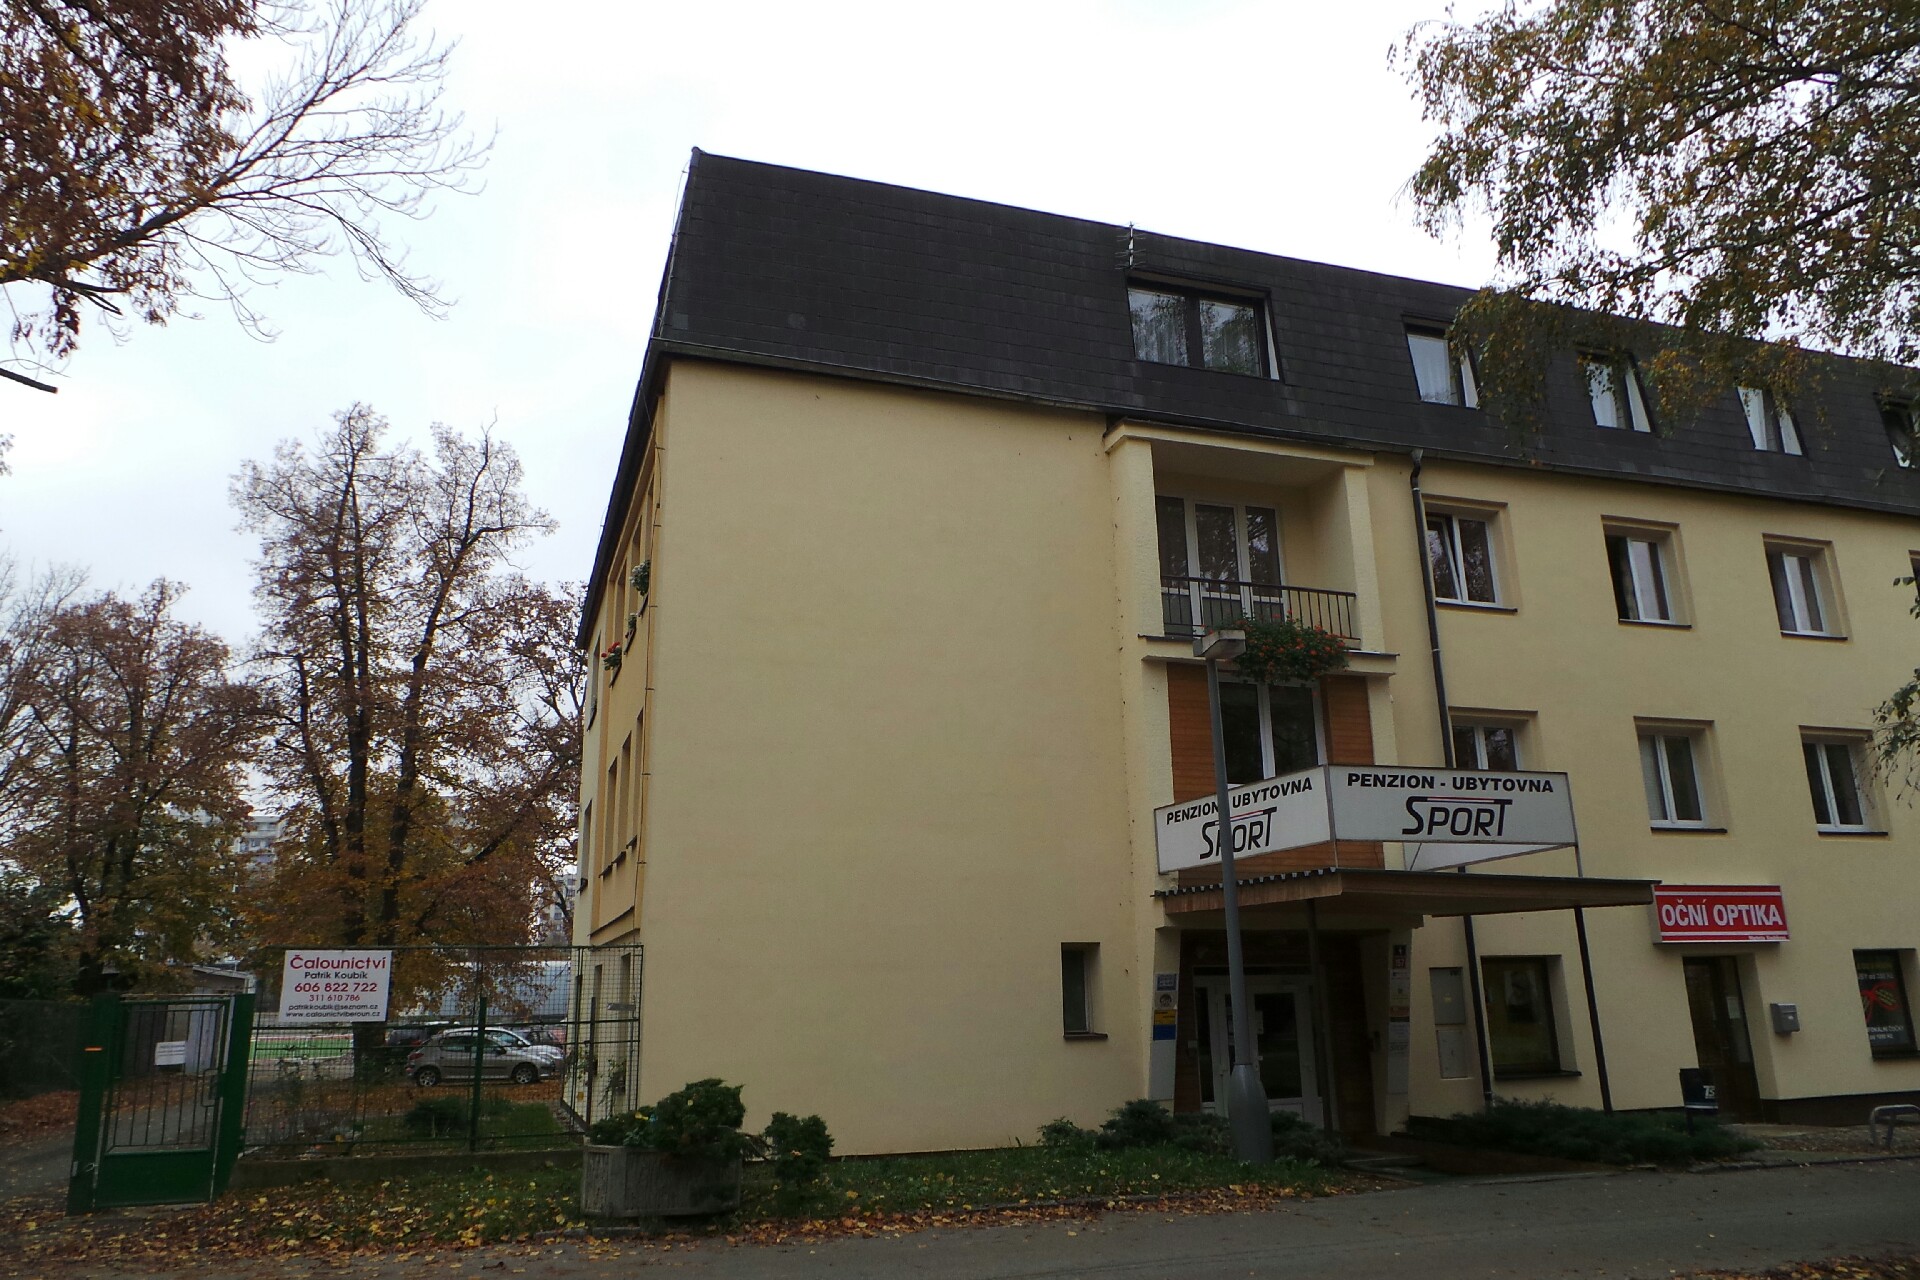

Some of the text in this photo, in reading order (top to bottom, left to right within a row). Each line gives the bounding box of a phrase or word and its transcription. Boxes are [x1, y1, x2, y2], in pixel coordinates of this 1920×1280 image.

[1347, 773, 1435, 789] PENZION
[1452, 776, 1554, 793] UBYTOVNA
[1166, 777, 1313, 825] PENZION UBYTOVNA
[1402, 796, 1513, 837] SPORT
[1661, 898, 1783, 927] OČNÍ OPTIKA
[290, 954, 386, 969] Čalounictví
[304, 971, 331, 979] Patrik
[294, 982, 377, 992] 606 822 722
